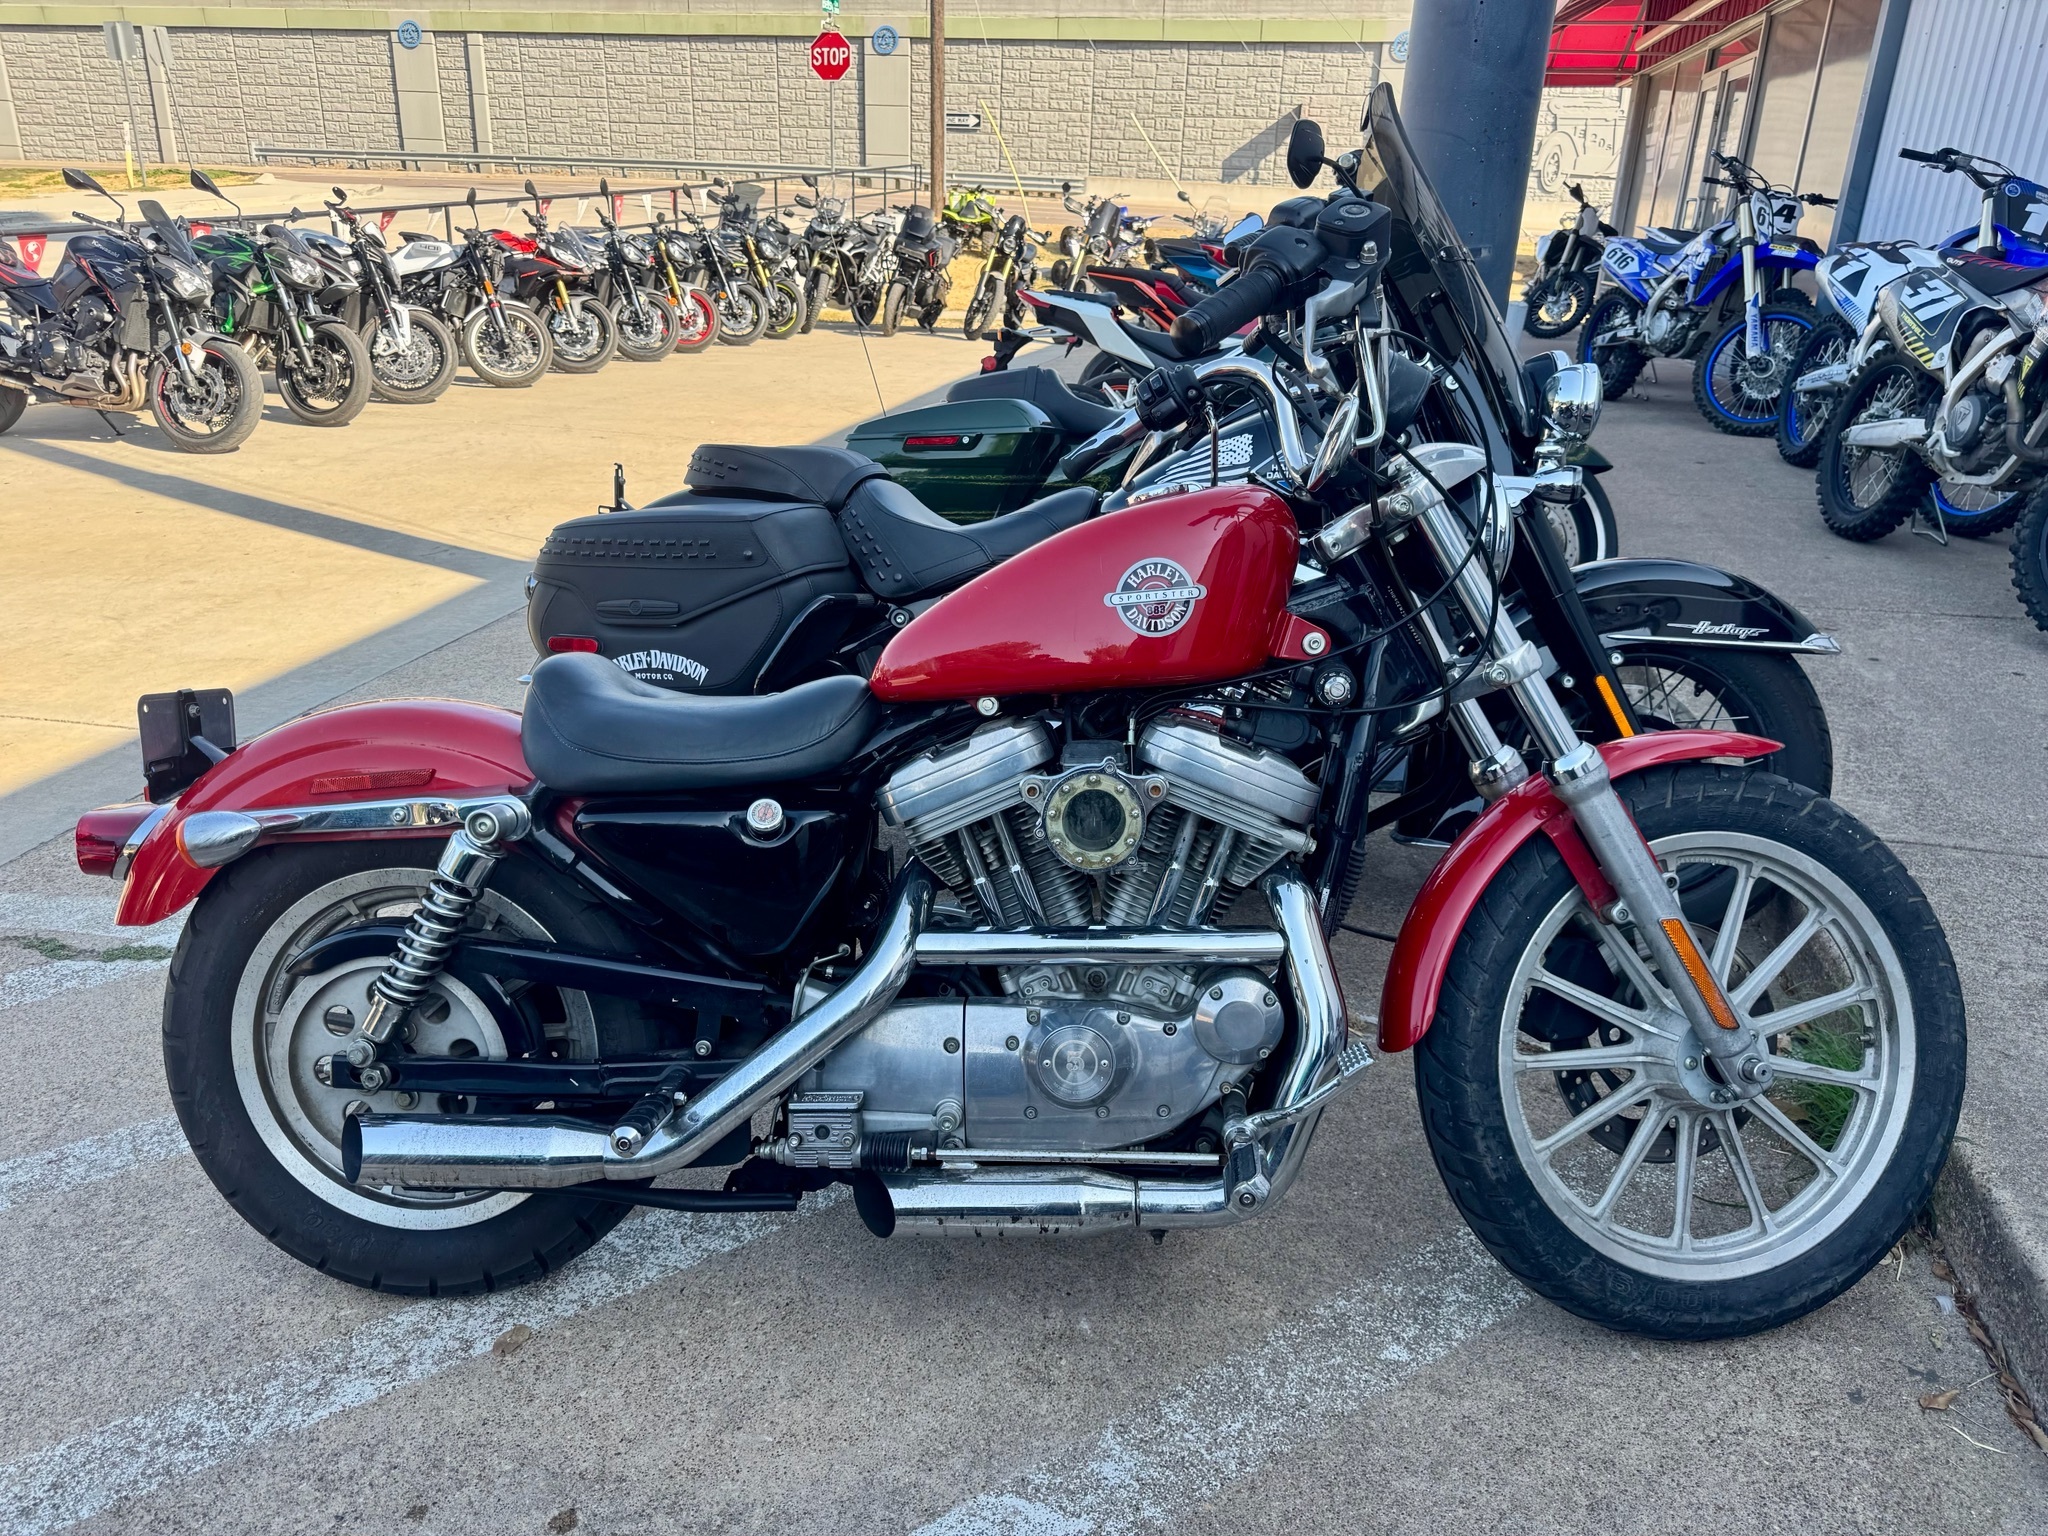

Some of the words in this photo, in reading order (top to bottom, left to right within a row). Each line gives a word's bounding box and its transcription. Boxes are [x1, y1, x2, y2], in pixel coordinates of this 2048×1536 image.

[812, 47, 849, 66] STOP
[1773, 203, 1797, 224] 4
[91, 239, 120, 258] Kawasaki
[1605, 246, 1635, 274] 616
[1903, 278, 1967, 322] 31
[1749, 312, 1760, 348] YAMAHA
[1126, 563, 1184, 588] HARLEY
[1118, 590, 1194, 603] SPORTSTER
[1126, 603, 1187, 631] DAVIDSON
[1146, 605, 1166, 615] 883
[1690, 620, 1764, 639] Heritage
[634, 672, 662, 680] MOTOR
